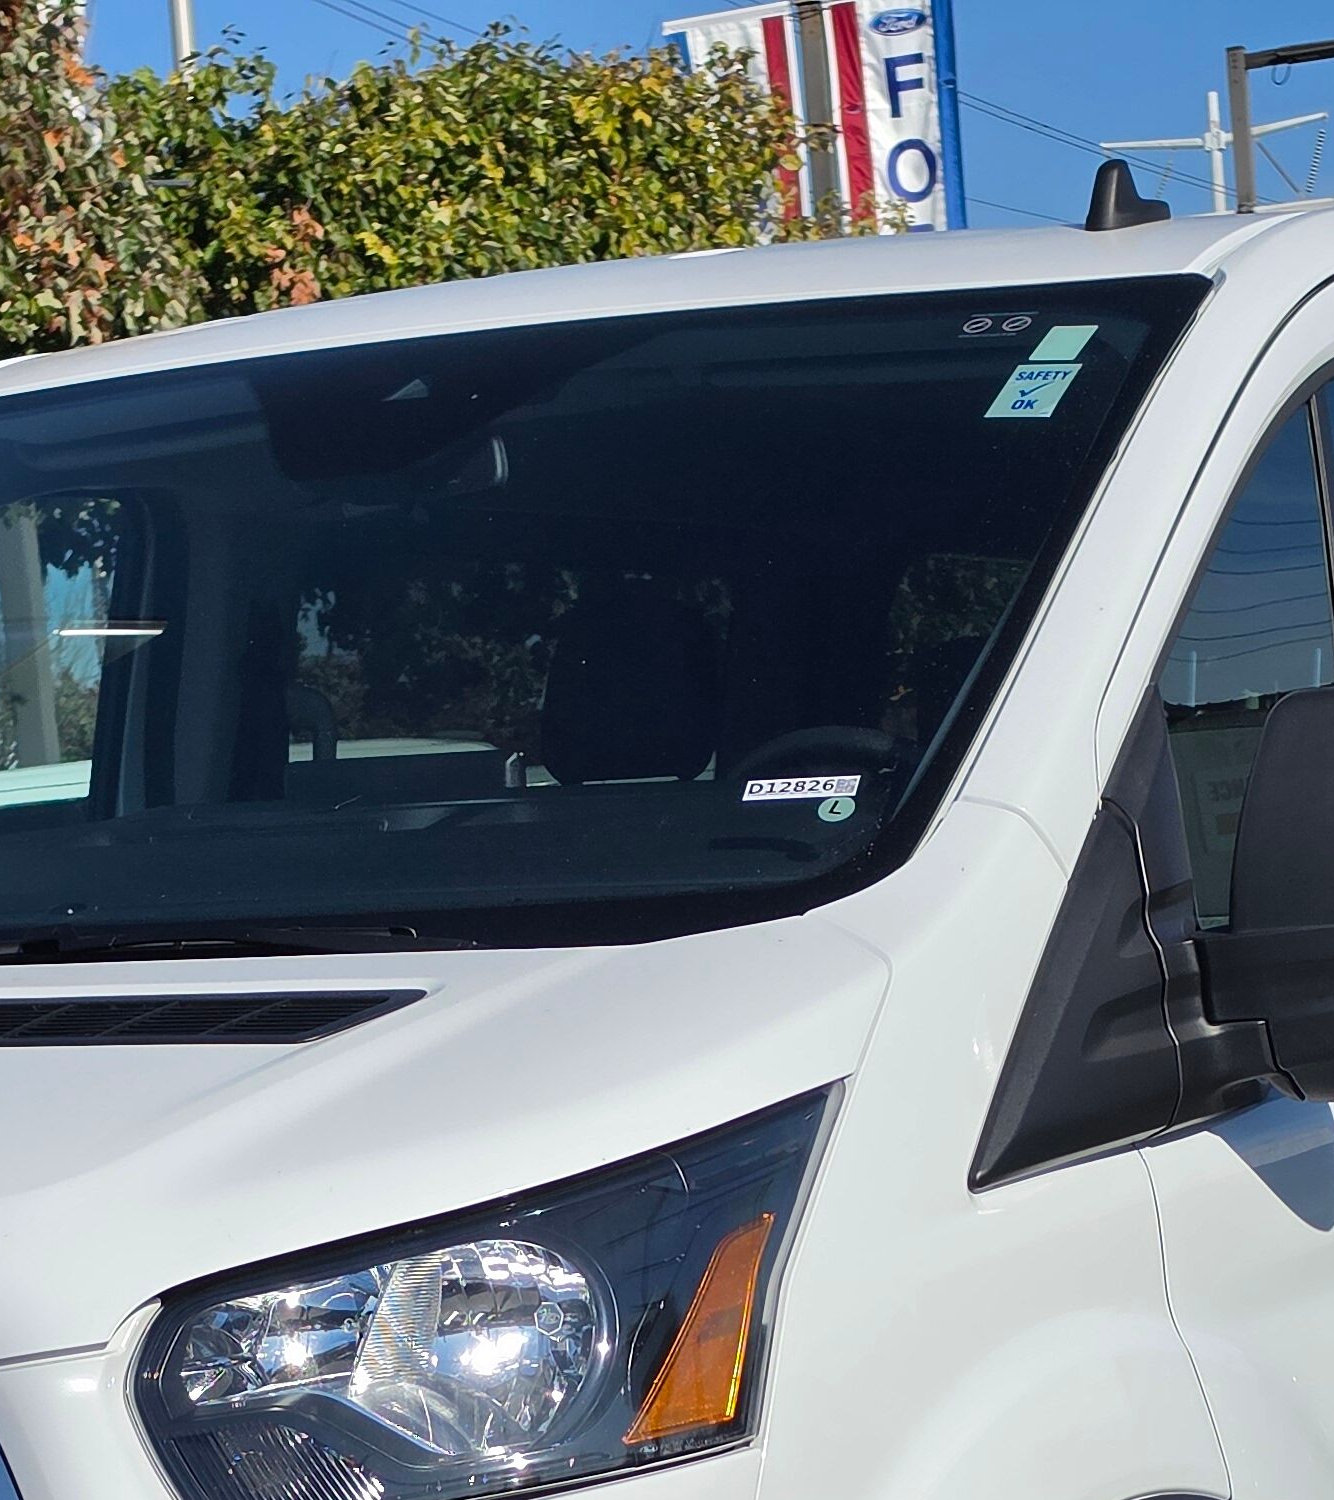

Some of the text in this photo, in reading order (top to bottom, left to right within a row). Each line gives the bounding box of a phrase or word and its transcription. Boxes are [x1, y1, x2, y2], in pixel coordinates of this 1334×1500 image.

[884, 53, 938, 232] FO
[1016, 370, 1072, 381] SAFETY
[1011, 399, 1039, 410] OK
[748, 779, 836, 795] D12826
[828, 800, 842, 815] L
